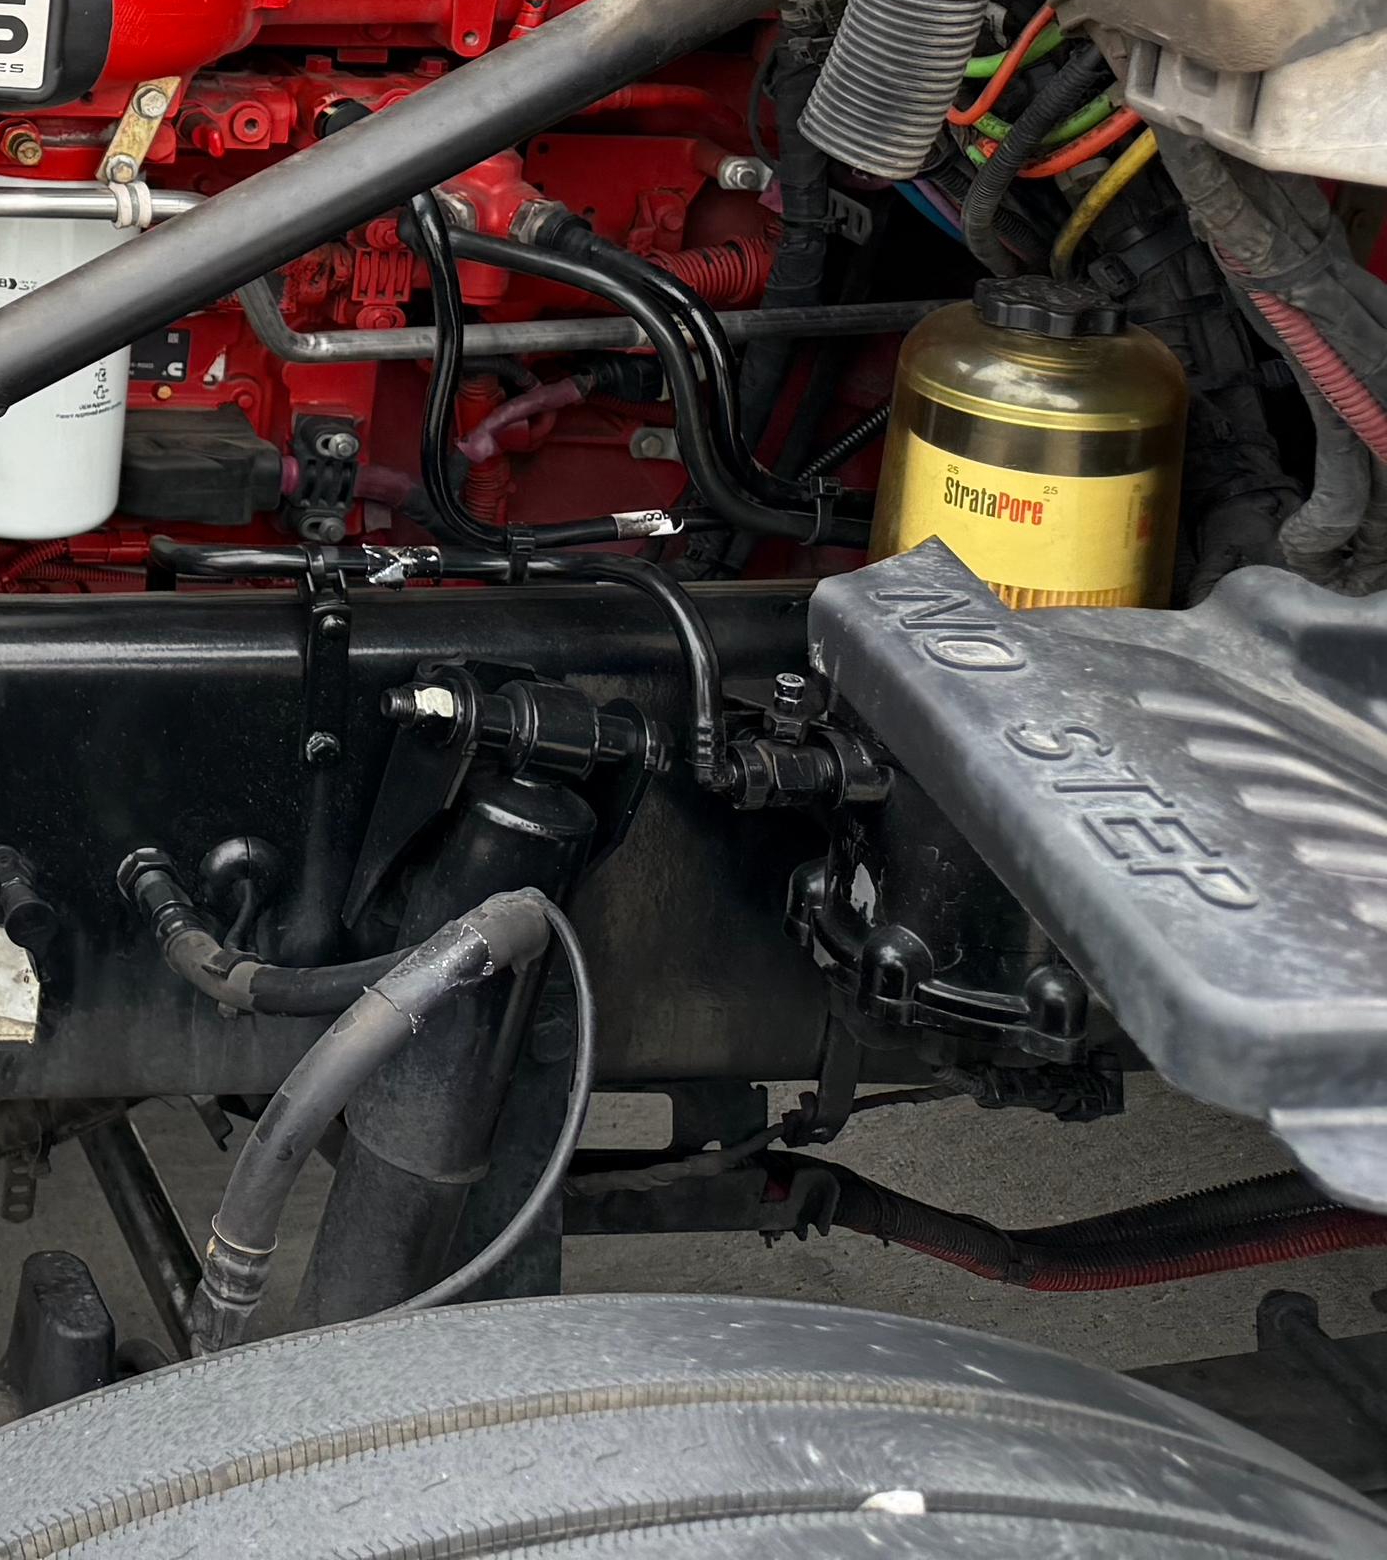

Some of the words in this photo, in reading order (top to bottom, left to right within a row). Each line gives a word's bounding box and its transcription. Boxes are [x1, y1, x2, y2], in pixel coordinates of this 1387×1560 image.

[947, 464, 960, 475] 25
[1043, 485, 1058, 495] 25
[944, 476, 1044, 526] StrataPore
[872, 589, 1027, 672] NO
[1004, 720, 1259, 910] STEP
